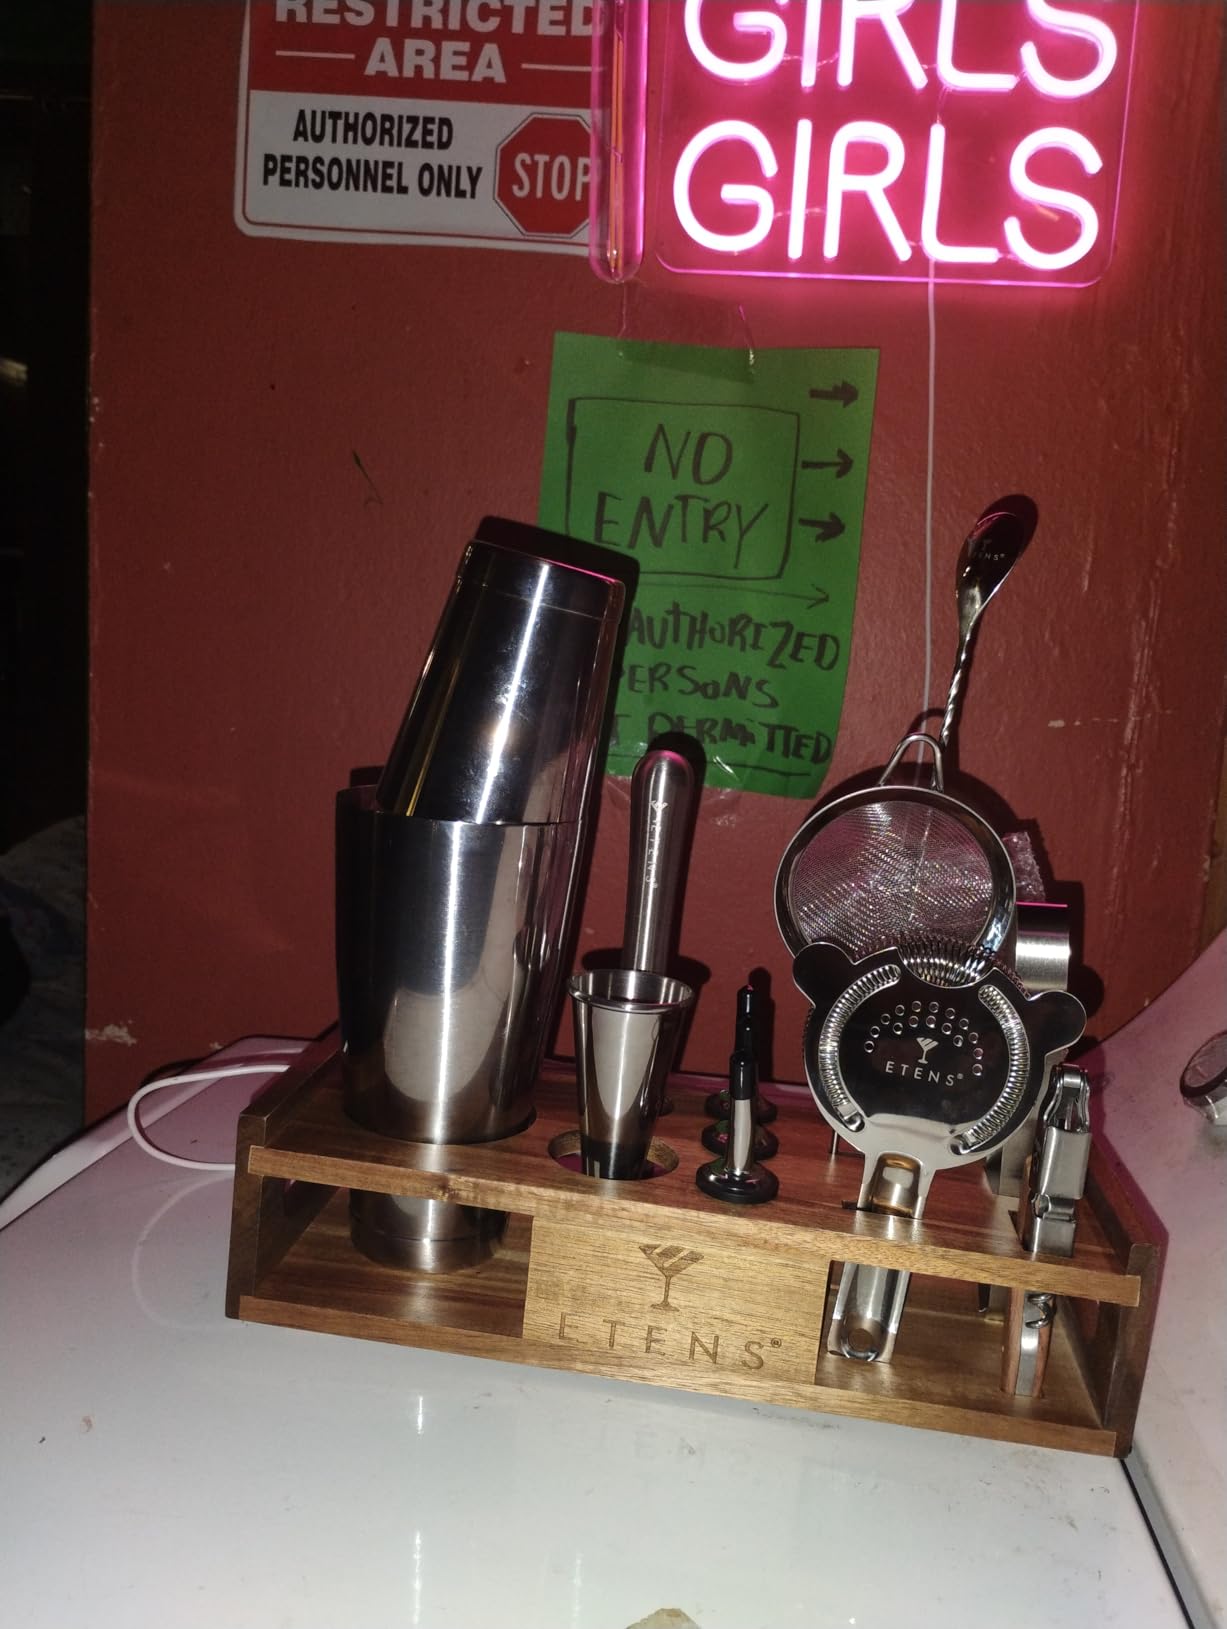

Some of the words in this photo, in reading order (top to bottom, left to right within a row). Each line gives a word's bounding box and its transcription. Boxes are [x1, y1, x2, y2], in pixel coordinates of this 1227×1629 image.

[275, 0, 605, 37] RESTRICTED
[363, 37, 507, 84] AREA
[684, 0, 1118, 99] GIRLS
[292, 109, 455, 151] AUTHORIZED
[262, 153, 409, 195] PERSONNEL
[417, 162, 484, 200] ONLY
[511, 152, 603, 202] STOP
[673, 118, 1103, 270] GIRLS
[643, 423, 734, 486] NO
[593, 491, 770, 570] ENTRY
[620, 662, 780, 709] ERSONS
